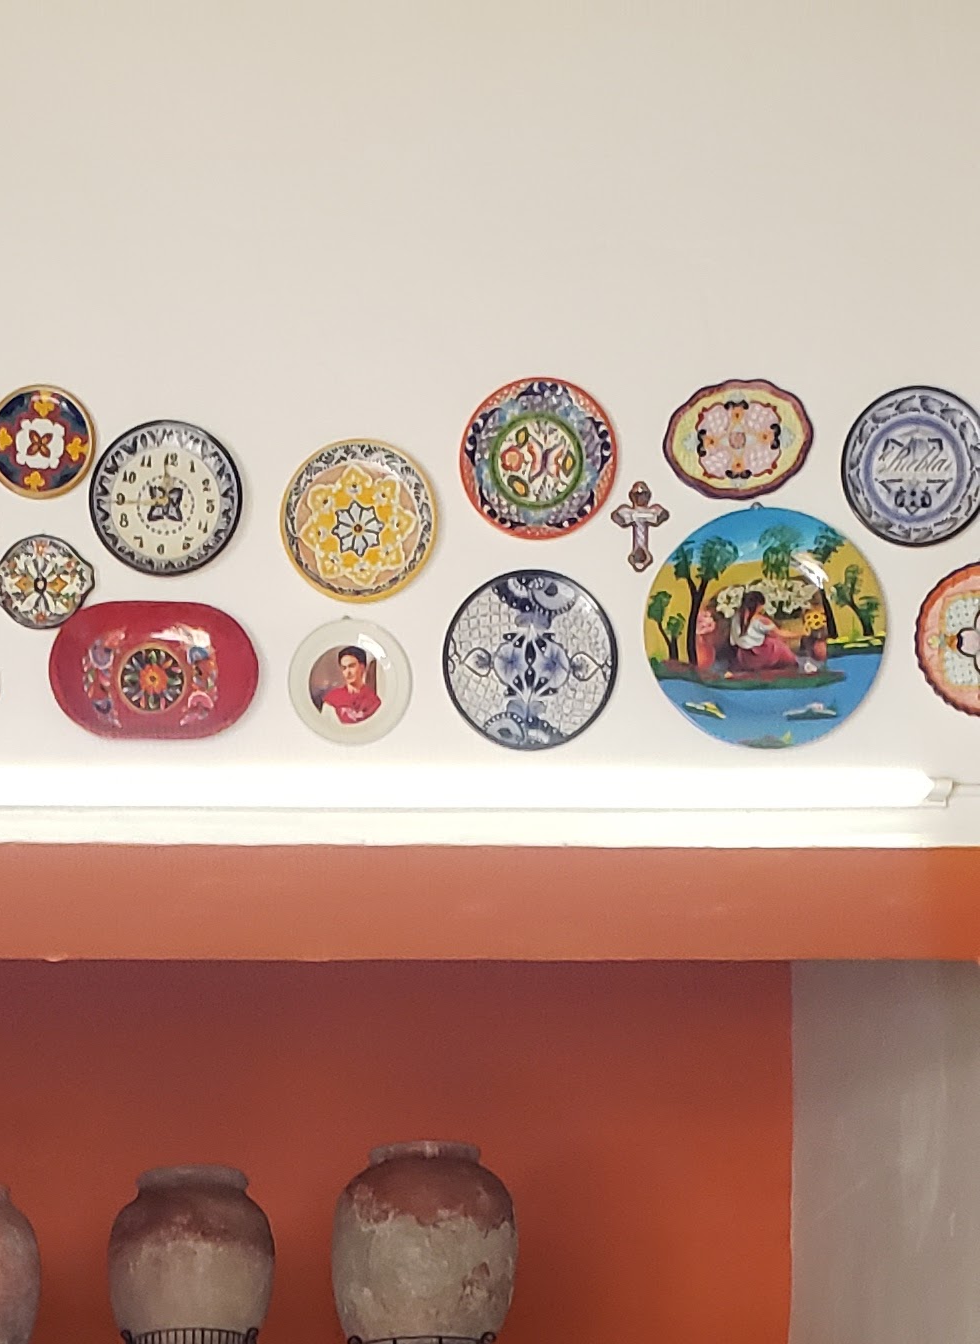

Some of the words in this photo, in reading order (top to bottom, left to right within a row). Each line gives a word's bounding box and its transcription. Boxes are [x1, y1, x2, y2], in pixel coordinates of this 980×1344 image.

[141, 455, 151, 468] 11
[164, 453, 178, 467] 12
[879, 445, 952, 472] Puebla
[189, 460, 195, 473] 1
[123, 470, 136, 484] 10
[202, 478, 211, 492] 2
[116, 493, 125, 506] 9
[206, 499, 215, 514] 3
[120, 513, 128, 528] 8
[198, 519, 208, 533] 4
[134, 536, 143, 548] 7
[182, 536, 194, 550] 5
[157, 544, 164, 555] 6
